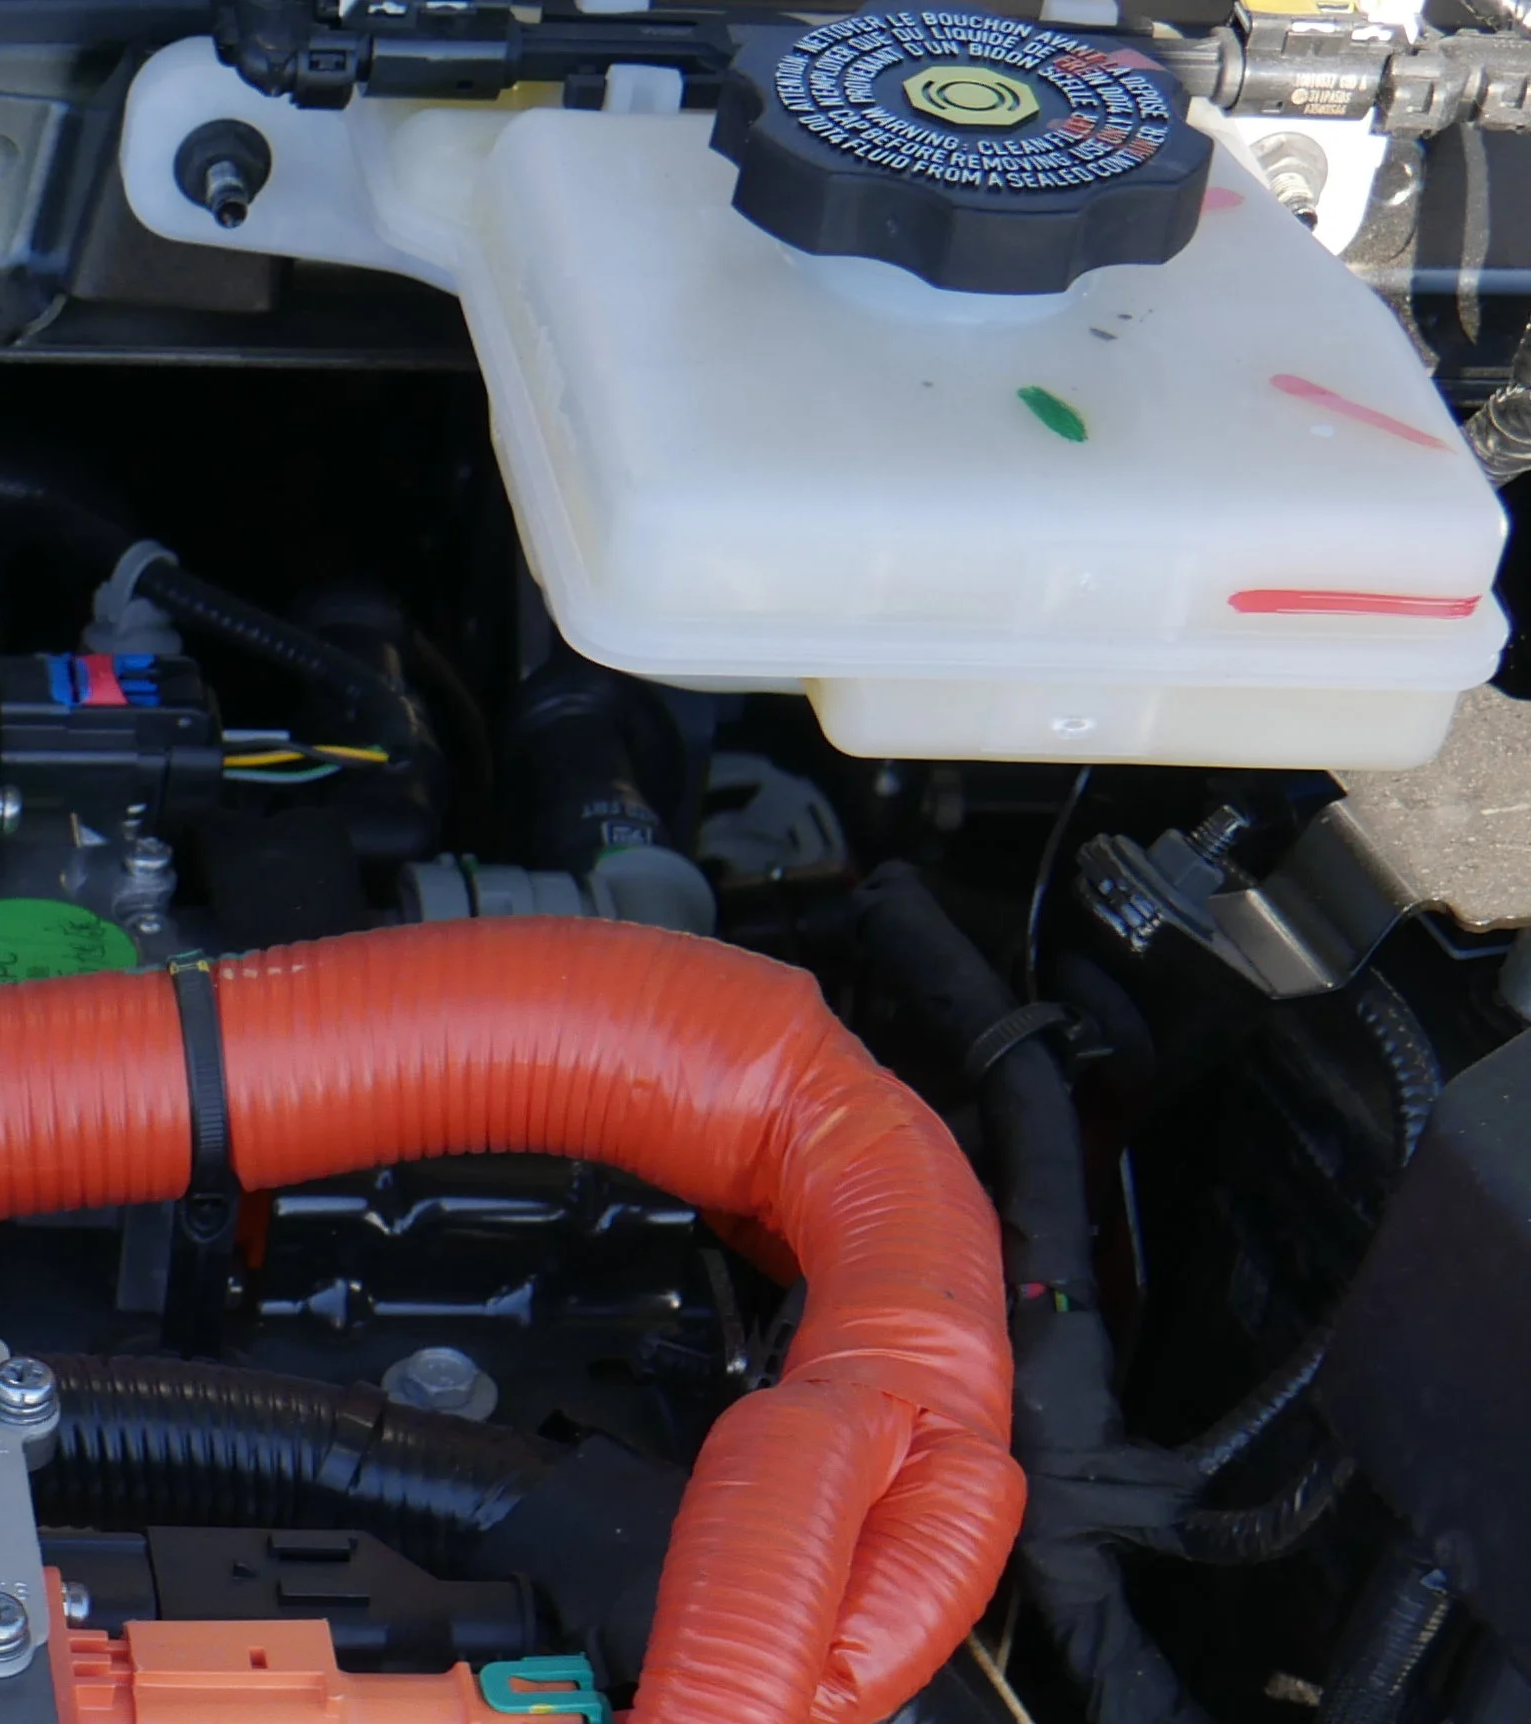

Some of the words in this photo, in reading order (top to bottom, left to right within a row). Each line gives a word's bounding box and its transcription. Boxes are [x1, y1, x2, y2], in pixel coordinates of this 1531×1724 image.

[794, 15, 887, 53] NETTOYER
[886, 12, 916, 28] LE
[921, 12, 1032, 38] BOUCHON
[1035, 30, 1108, 62] AVANT
[1099, 62, 1131, 77] LA
[1119, 75, 1169, 119] DEPOSE
[843, 46, 905, 103] PROVENANT
[902, 41, 959, 57] D'UN
[968, 43, 1042, 70] BIDON
[1038, 66, 1099, 108] SCELLE
[848, 31, 893, 51] QUE
[892, 27, 924, 42] DU
[930, 27, 1020, 48] LIQUIDE
[1023, 41, 1057, 59] DE
[1053, 55, 1114, 86] FREIN
[1097, 86, 1133, 114] DOT4
[798, 113, 850, 145] DOT4
[841, 138, 911, 169] FLUID
[911, 161, 982, 186] FROM
[987, 171, 1004, 187] A
[1005, 165, 1095, 188] SEALED
[827, 109, 872, 131] CAP
[860, 128, 947, 163] BEFORE
[1070, 138, 1115, 161] USE
[1096, 116, 1133, 147] ONLY
[977, 132, 1054, 155] CLEAN
